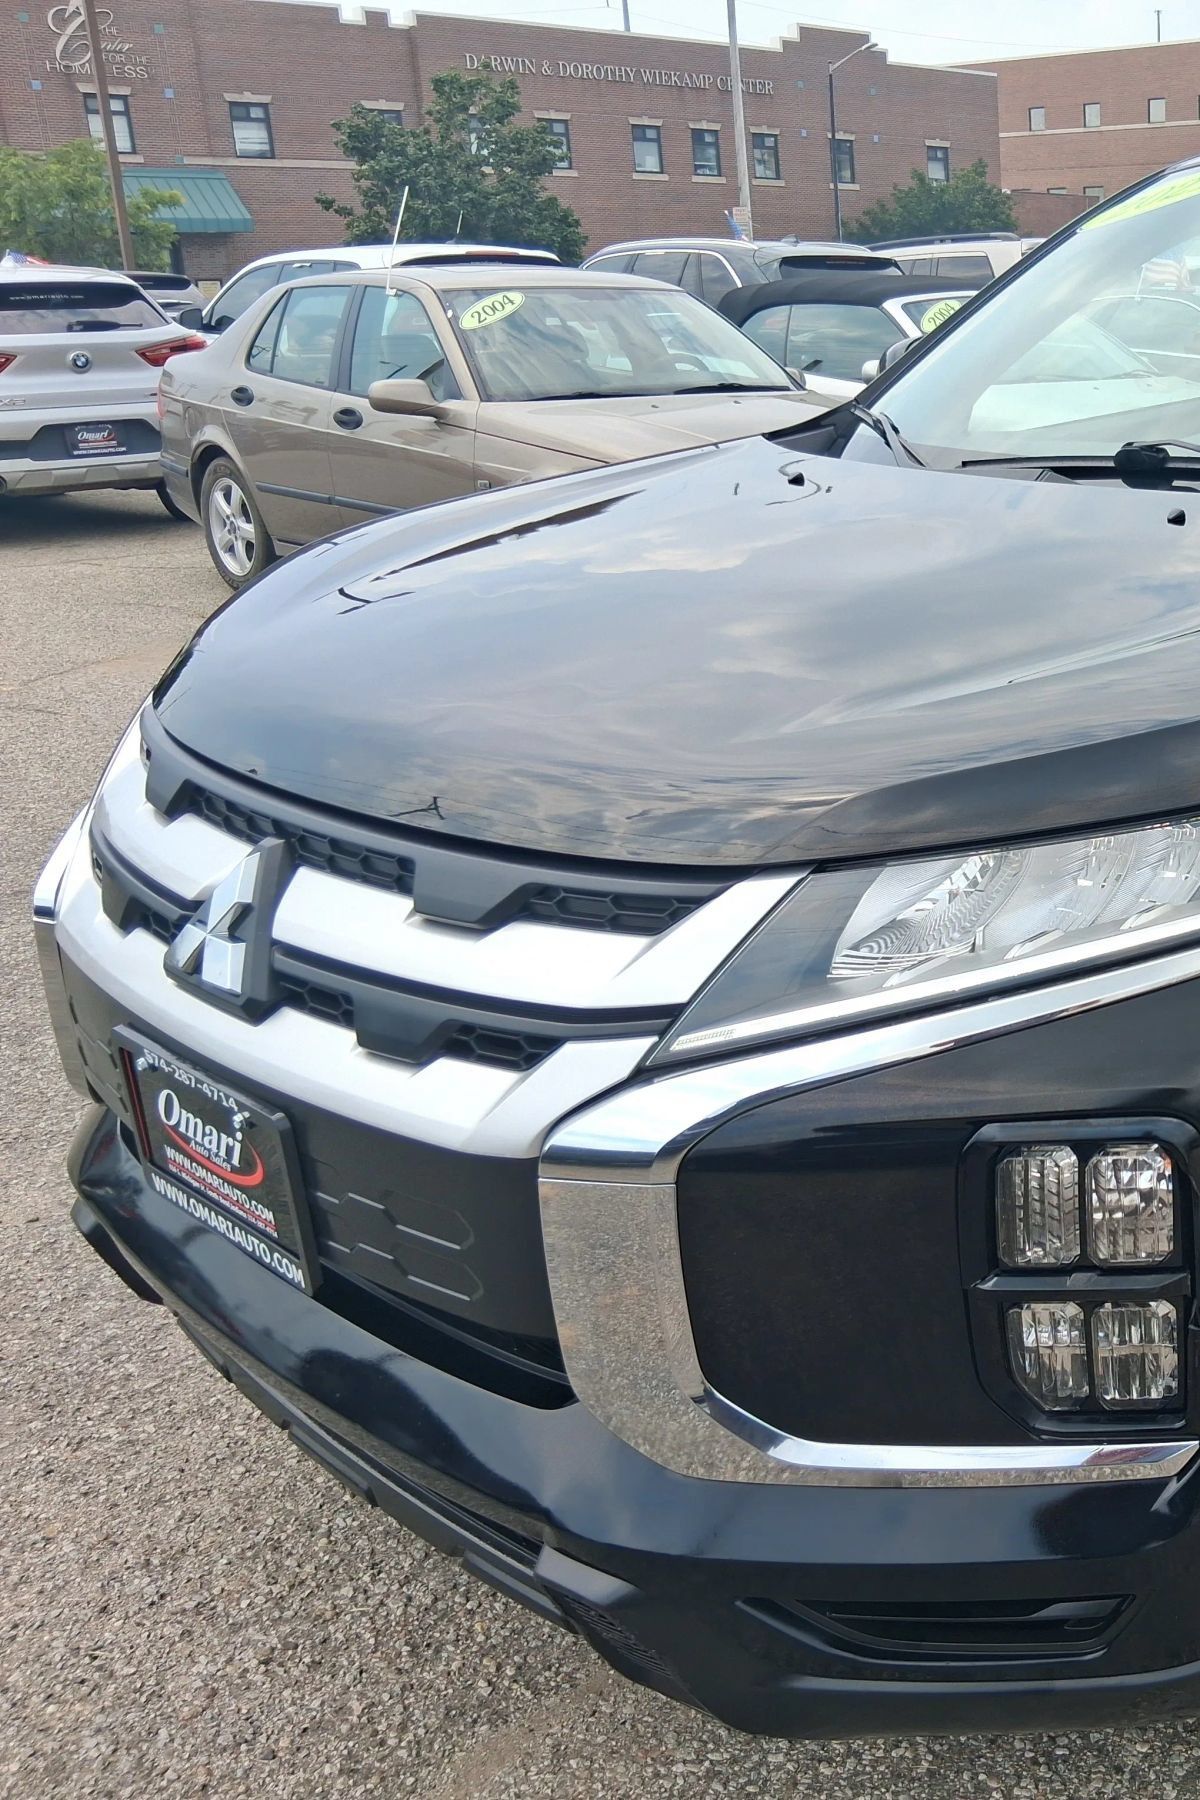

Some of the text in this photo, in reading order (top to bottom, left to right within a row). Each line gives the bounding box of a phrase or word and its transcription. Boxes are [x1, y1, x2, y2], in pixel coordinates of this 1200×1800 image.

[46, 60, 148, 79] HOMESS
[103, 53, 151, 64] FOR THE
[541, 59, 554, 76] &
[558, 61, 637, 83] DOROTHY
[640, 68, 713, 89] WIEKAMP
[471, 295, 516, 324] 2004
[928, 302, 955, 327] 2004
[144, 1049, 239, 1112] 574-287-4714
[158, 1089, 243, 1168] Omari
[189, 1140, 232, 1172] Auto Sales
[164, 1144, 276, 1224] WWW.OMARIAUTO.COM
[151, 1172, 306, 1289] WWW.OMARIAUTO.COM
